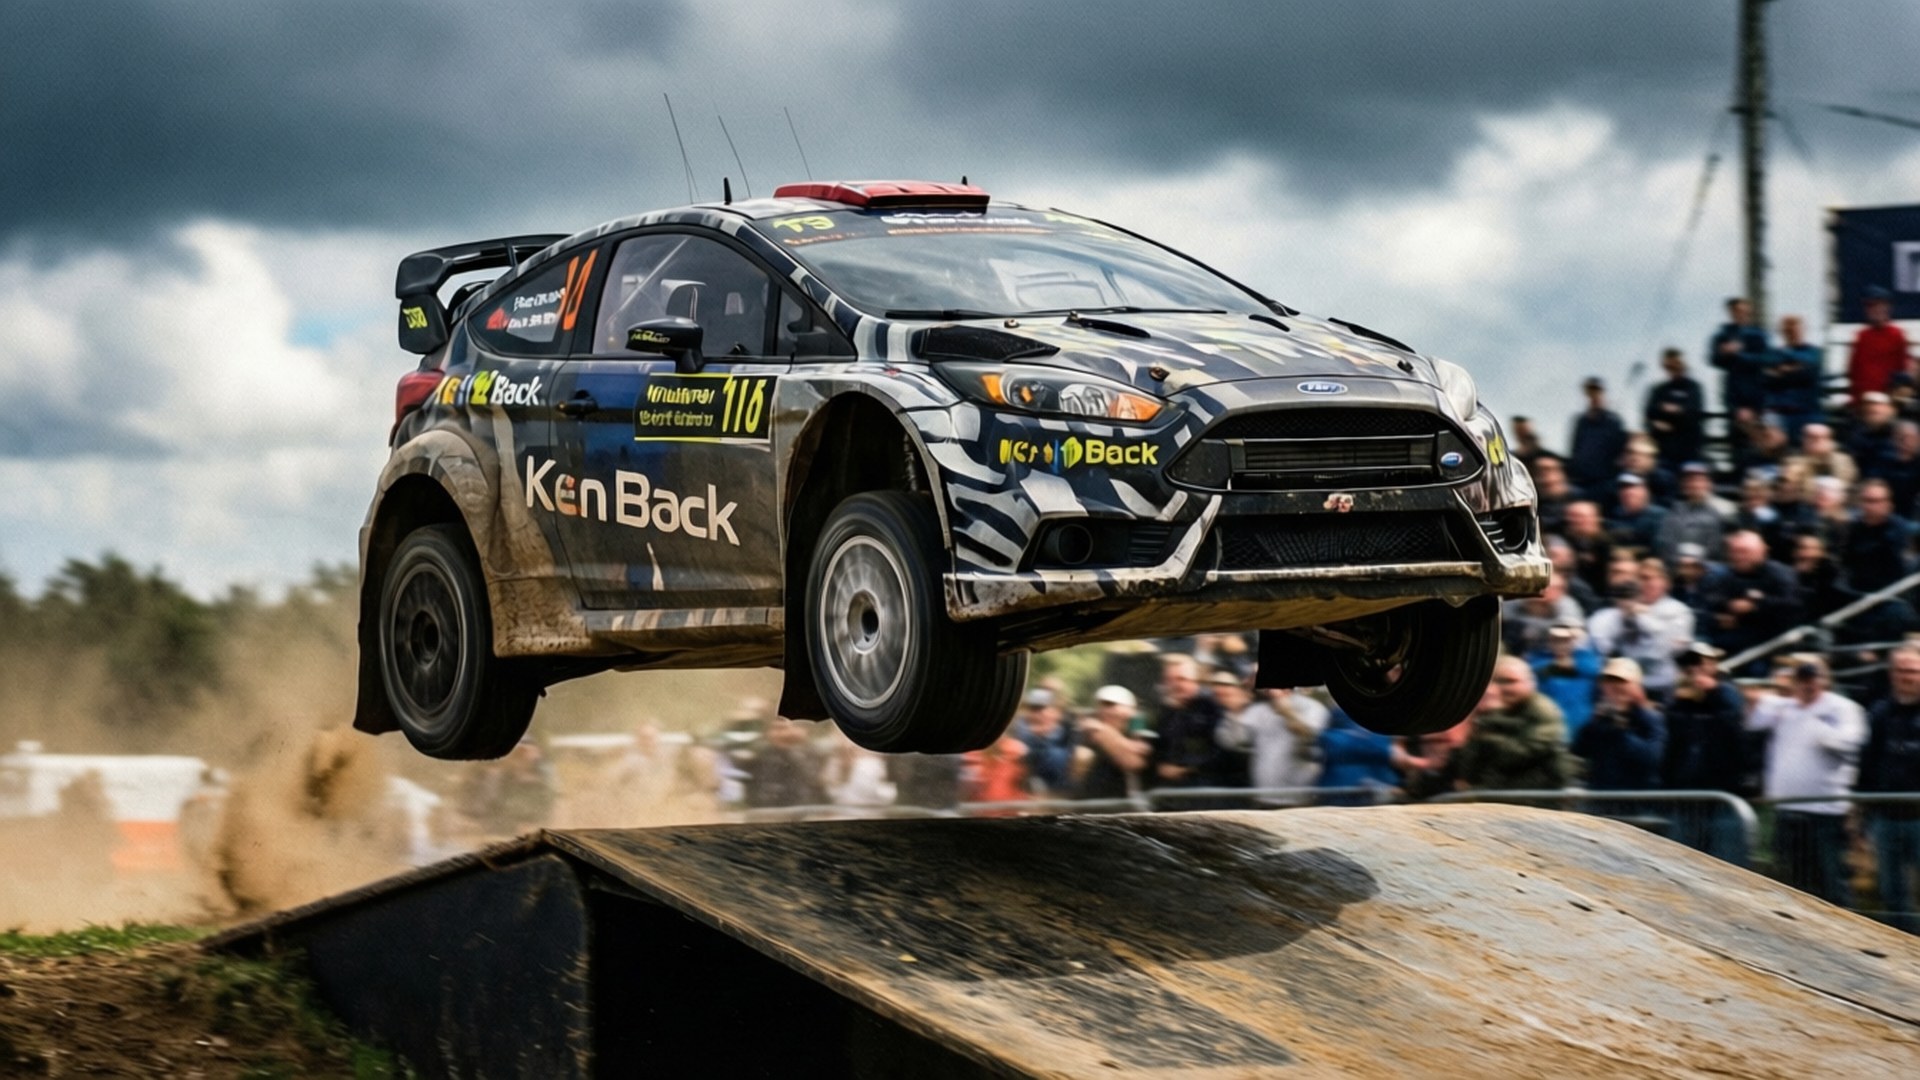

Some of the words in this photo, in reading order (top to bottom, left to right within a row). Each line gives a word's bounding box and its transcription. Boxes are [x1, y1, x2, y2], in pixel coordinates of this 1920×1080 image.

[489, 372, 543, 407] Back
[722, 376, 768, 434] 116
[1085, 439, 1160, 466] Back
[526, 454, 608, 523] Ken
[615, 469, 741, 547] Back
